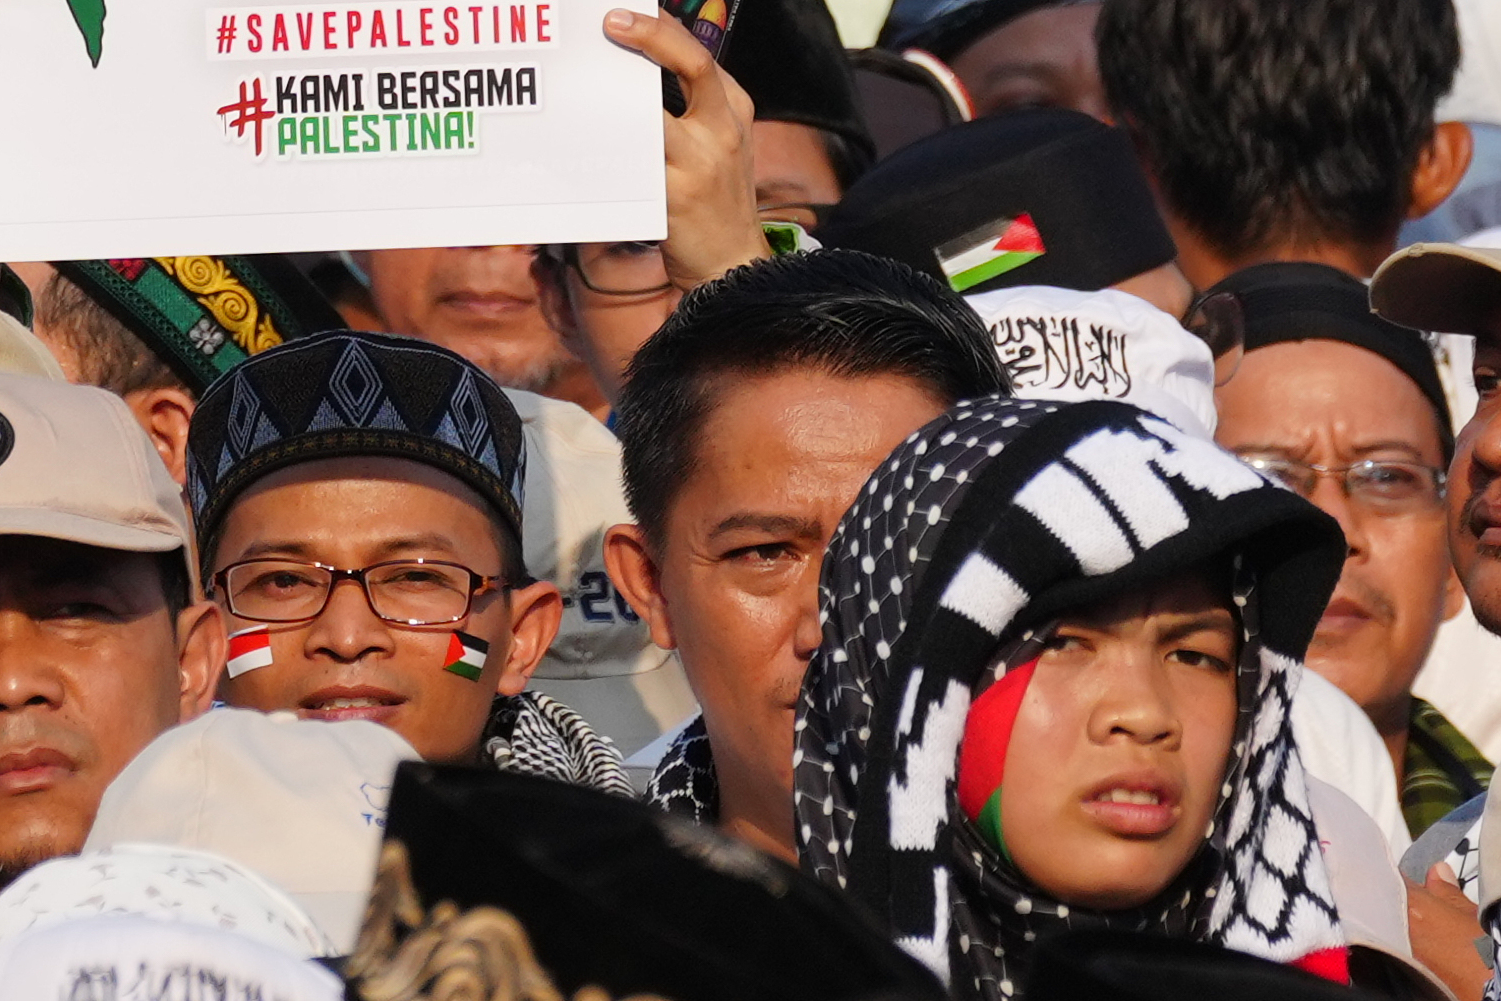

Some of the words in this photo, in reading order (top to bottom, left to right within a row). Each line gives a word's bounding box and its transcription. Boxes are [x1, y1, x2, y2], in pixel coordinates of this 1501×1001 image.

[216, 4, 551, 53] #SAVEPALESTINE
[377, 68, 537, 110] BERSAMA
[277, 111, 475, 156] PALESTINA!
